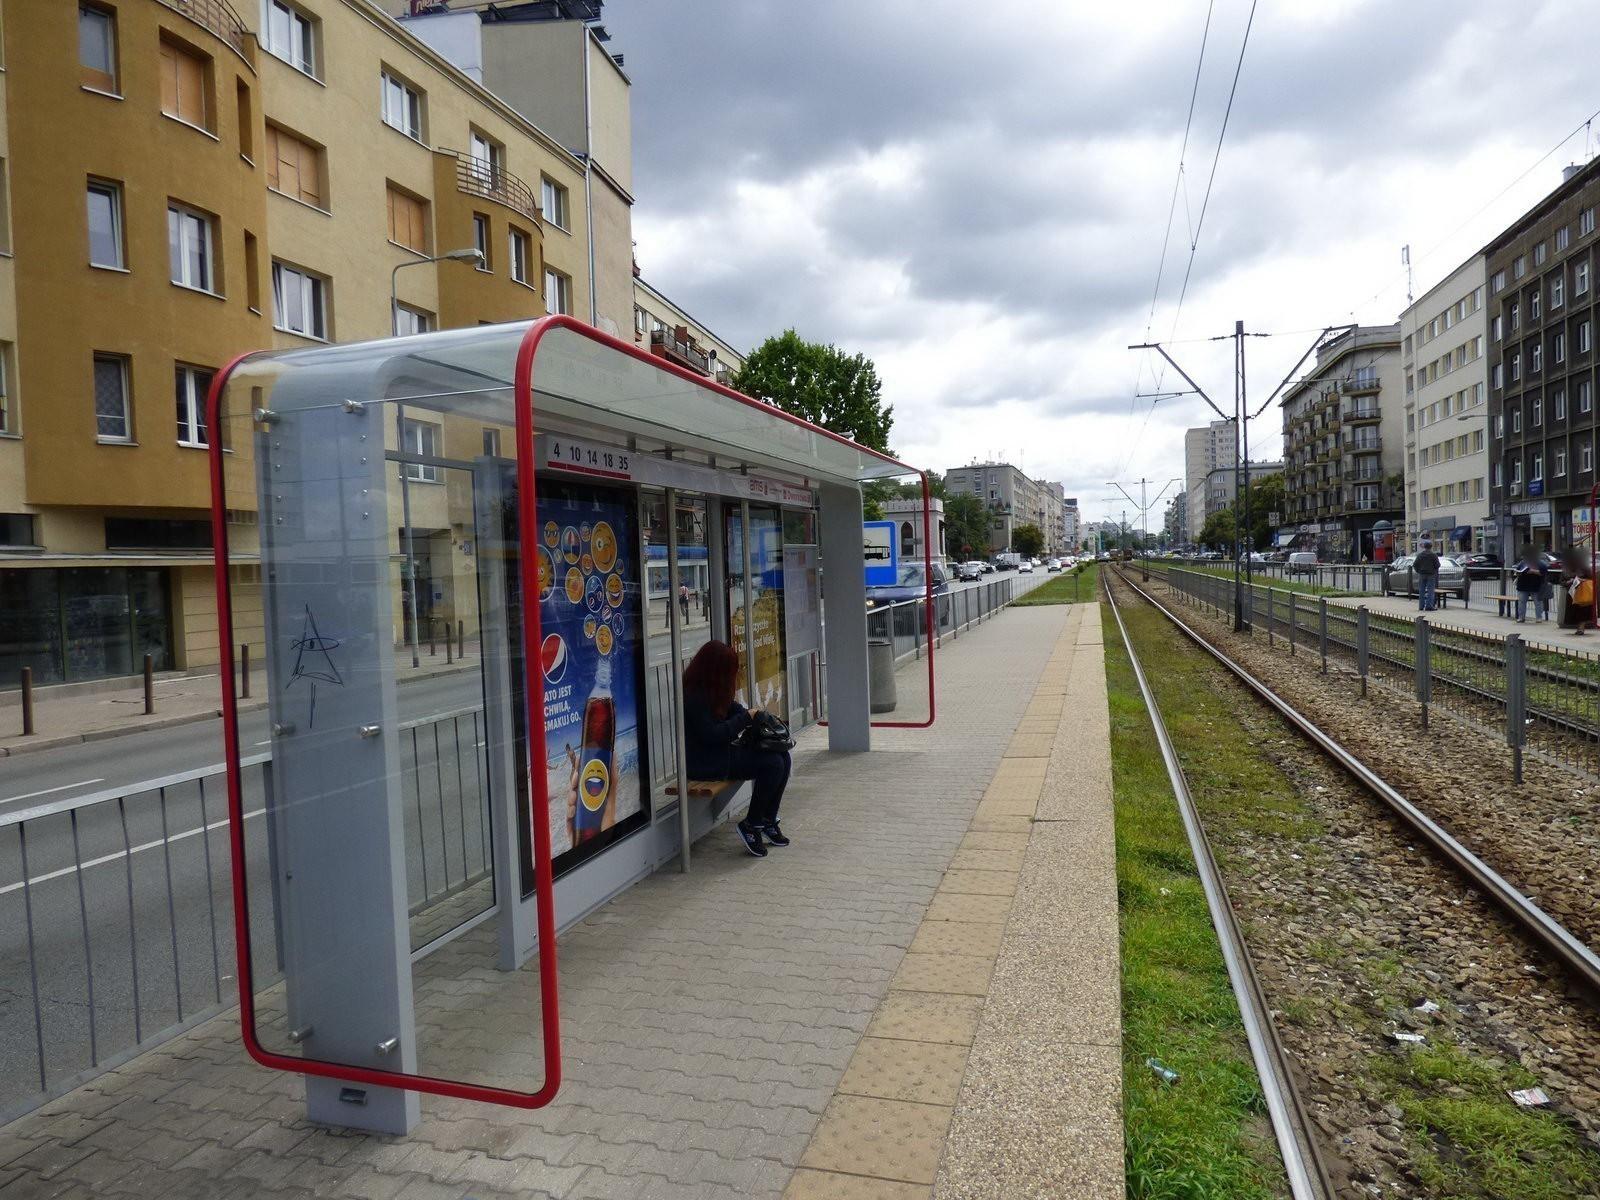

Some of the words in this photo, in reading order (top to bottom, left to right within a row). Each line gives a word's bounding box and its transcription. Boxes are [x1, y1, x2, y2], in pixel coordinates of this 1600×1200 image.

[554, 443, 560, 457] 4
[570, 446, 580, 461] 10
[587, 450, 597, 464] 14
[603, 453, 613, 467] 18
[619, 456, 628, 470] 35
[544, 689, 557, 703] ATO
[558, 685, 572, 698] JEST
